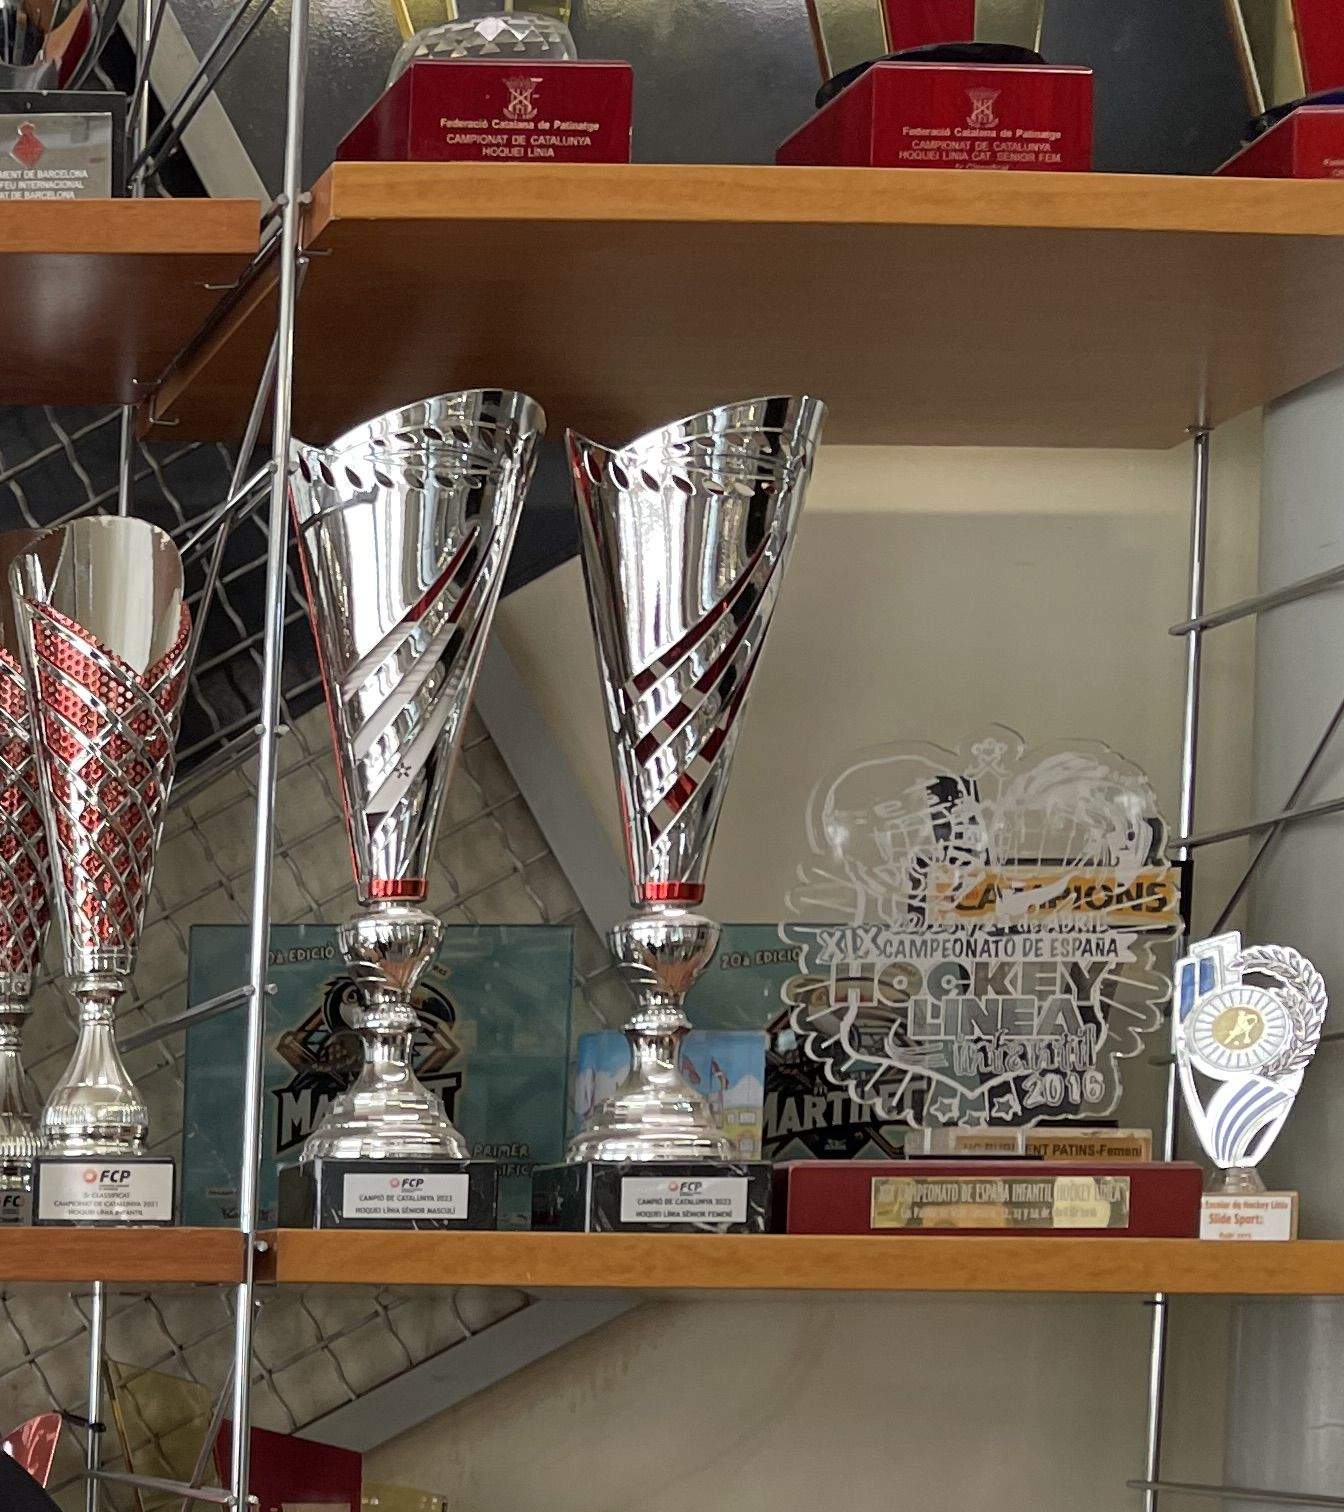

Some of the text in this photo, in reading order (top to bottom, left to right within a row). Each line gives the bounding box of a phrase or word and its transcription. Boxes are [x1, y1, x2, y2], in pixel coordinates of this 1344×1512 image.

[440, 118, 600, 132] Federació Catalana de Patinatge
[902, 126, 1062, 141] Federació Catalana de Patinatge
[446, 134, 592, 146] CAMPIONAT DE CATALUNYA
[912, 140, 1052, 151] CAMPIONAT DE CATALUNYA
[482, 146, 524, 157] HOQUEI
[898, 151, 941, 160] HOQUEI
[24, 170, 36, 179] DE
[37, 169, 89, 179] BARCELONA
[17, 181, 85, 190] INTERNACIONAL
[25, 191, 76, 199] BARCELONA
[884, 937, 1013, 959] CAMPEONATO
[1021, 936, 1043, 958] DE
[1050, 934, 1119, 958] ESPAÑA
[830, 960, 1111, 1006] HOCKEY
[1021, 1070, 1106, 1109] 2016
[100, 1170, 131, 1183] FCP
[401, 1178, 424, 1188] FCP
[680, 1181, 703, 1191] FCP
[962, 1184, 974, 1202] DE
[975, 1180, 1010, 1203] ESPAÑA
[1012, 1183, 1053, 1203] INFANTIL
